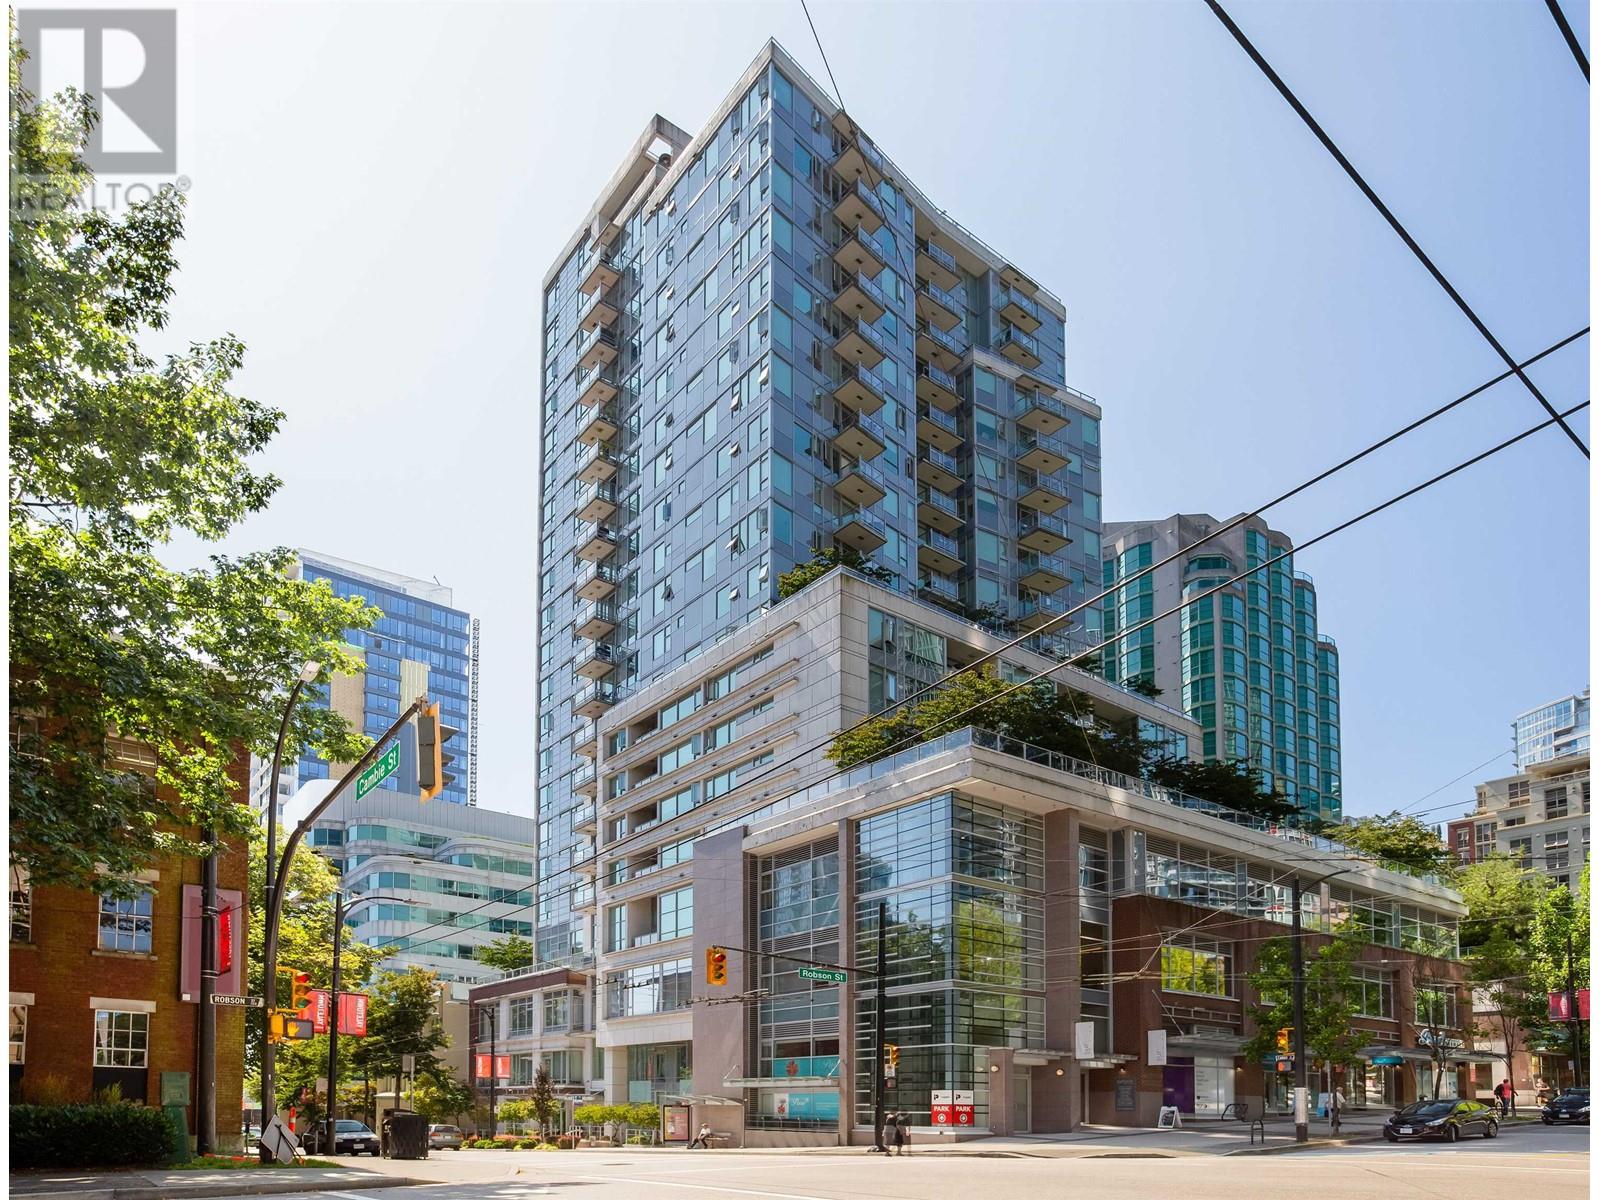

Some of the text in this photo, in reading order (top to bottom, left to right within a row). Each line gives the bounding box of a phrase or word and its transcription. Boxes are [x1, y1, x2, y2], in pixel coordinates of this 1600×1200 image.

[358, 750, 397, 795] Cambie St
[802, 969, 844, 981] Robson St
[214, 996, 246, 1005] ROBSON
